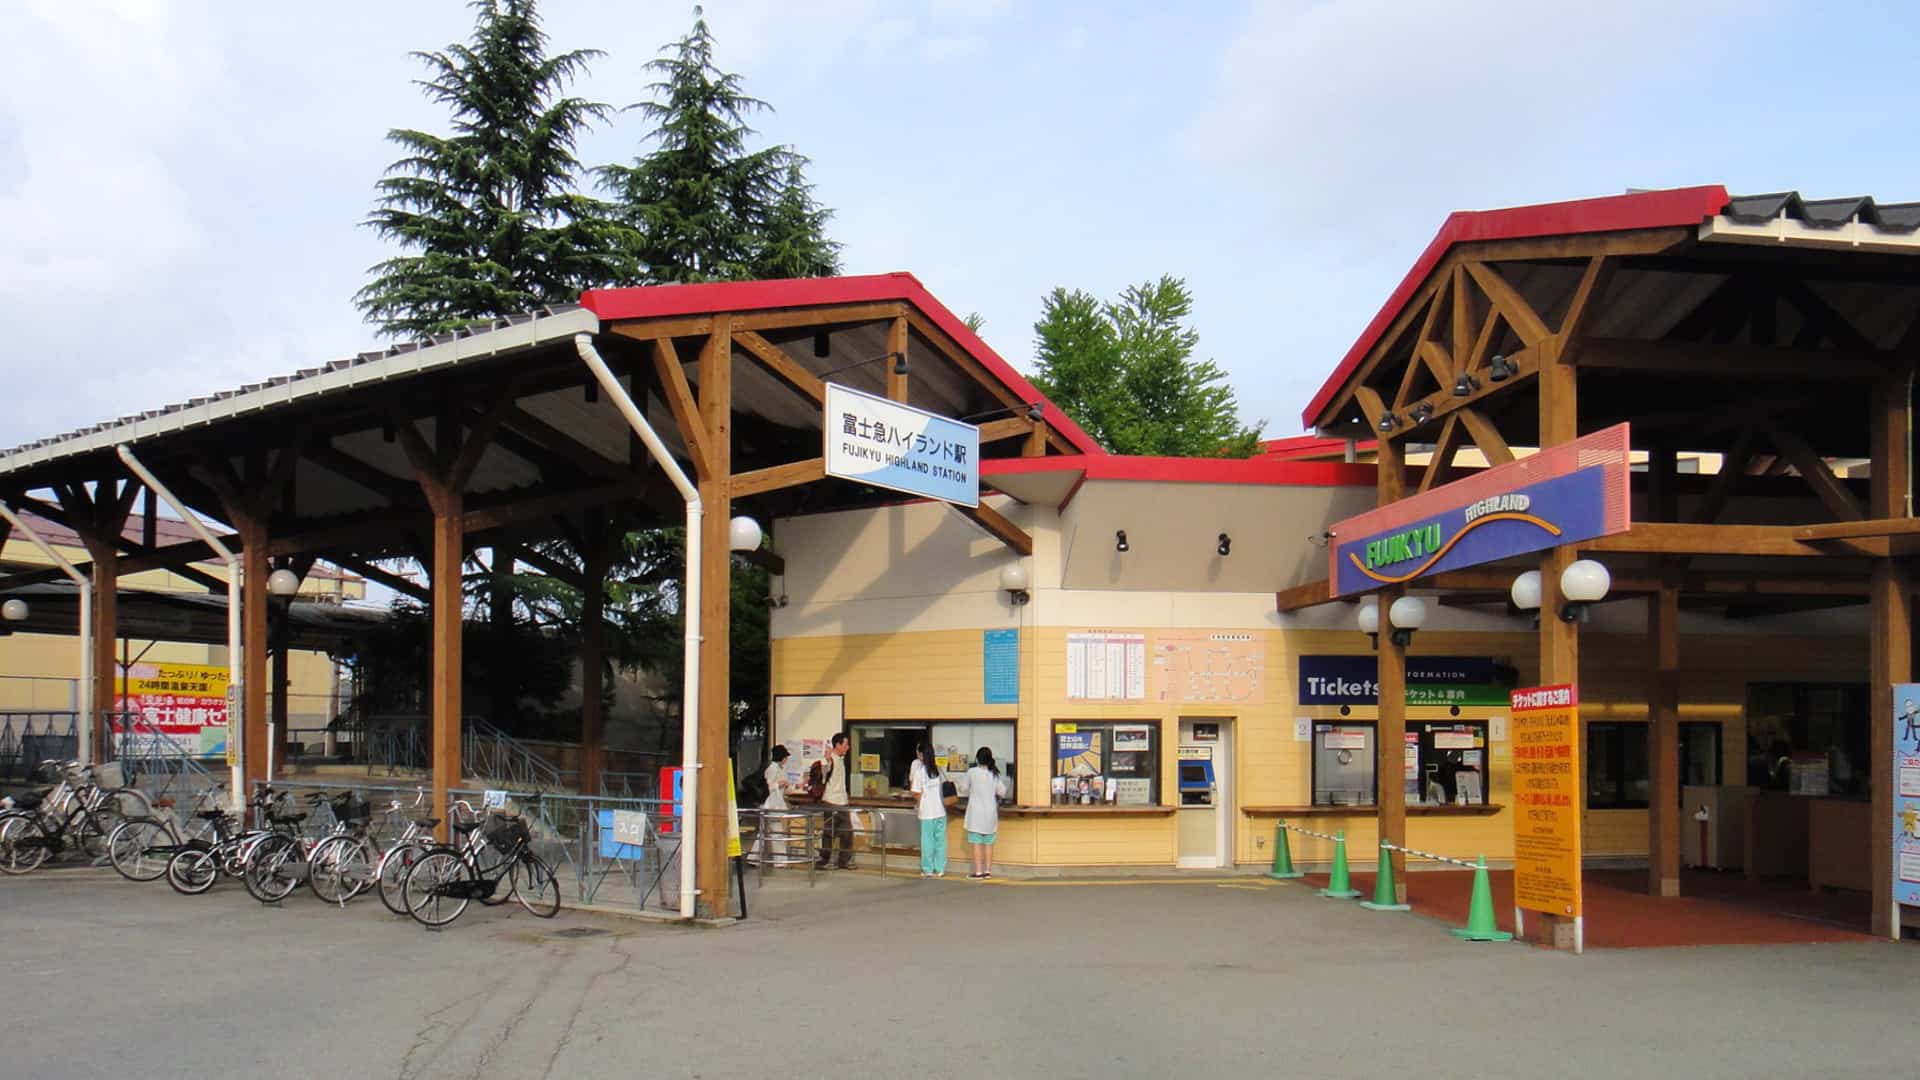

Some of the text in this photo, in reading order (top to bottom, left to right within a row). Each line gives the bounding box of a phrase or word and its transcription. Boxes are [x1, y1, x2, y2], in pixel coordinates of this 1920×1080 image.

[842, 412, 967, 465] 富士急ハイランド駅
[842, 442, 967, 484] FUJIKYU HIGHLAND STATION
[1465, 494, 1530, 522] HIGHLAND
[1366, 523, 1441, 571] FUJIKYU
[1307, 677, 1380, 696] Tickets
[142, 706, 229, 726] 富士健康セ
